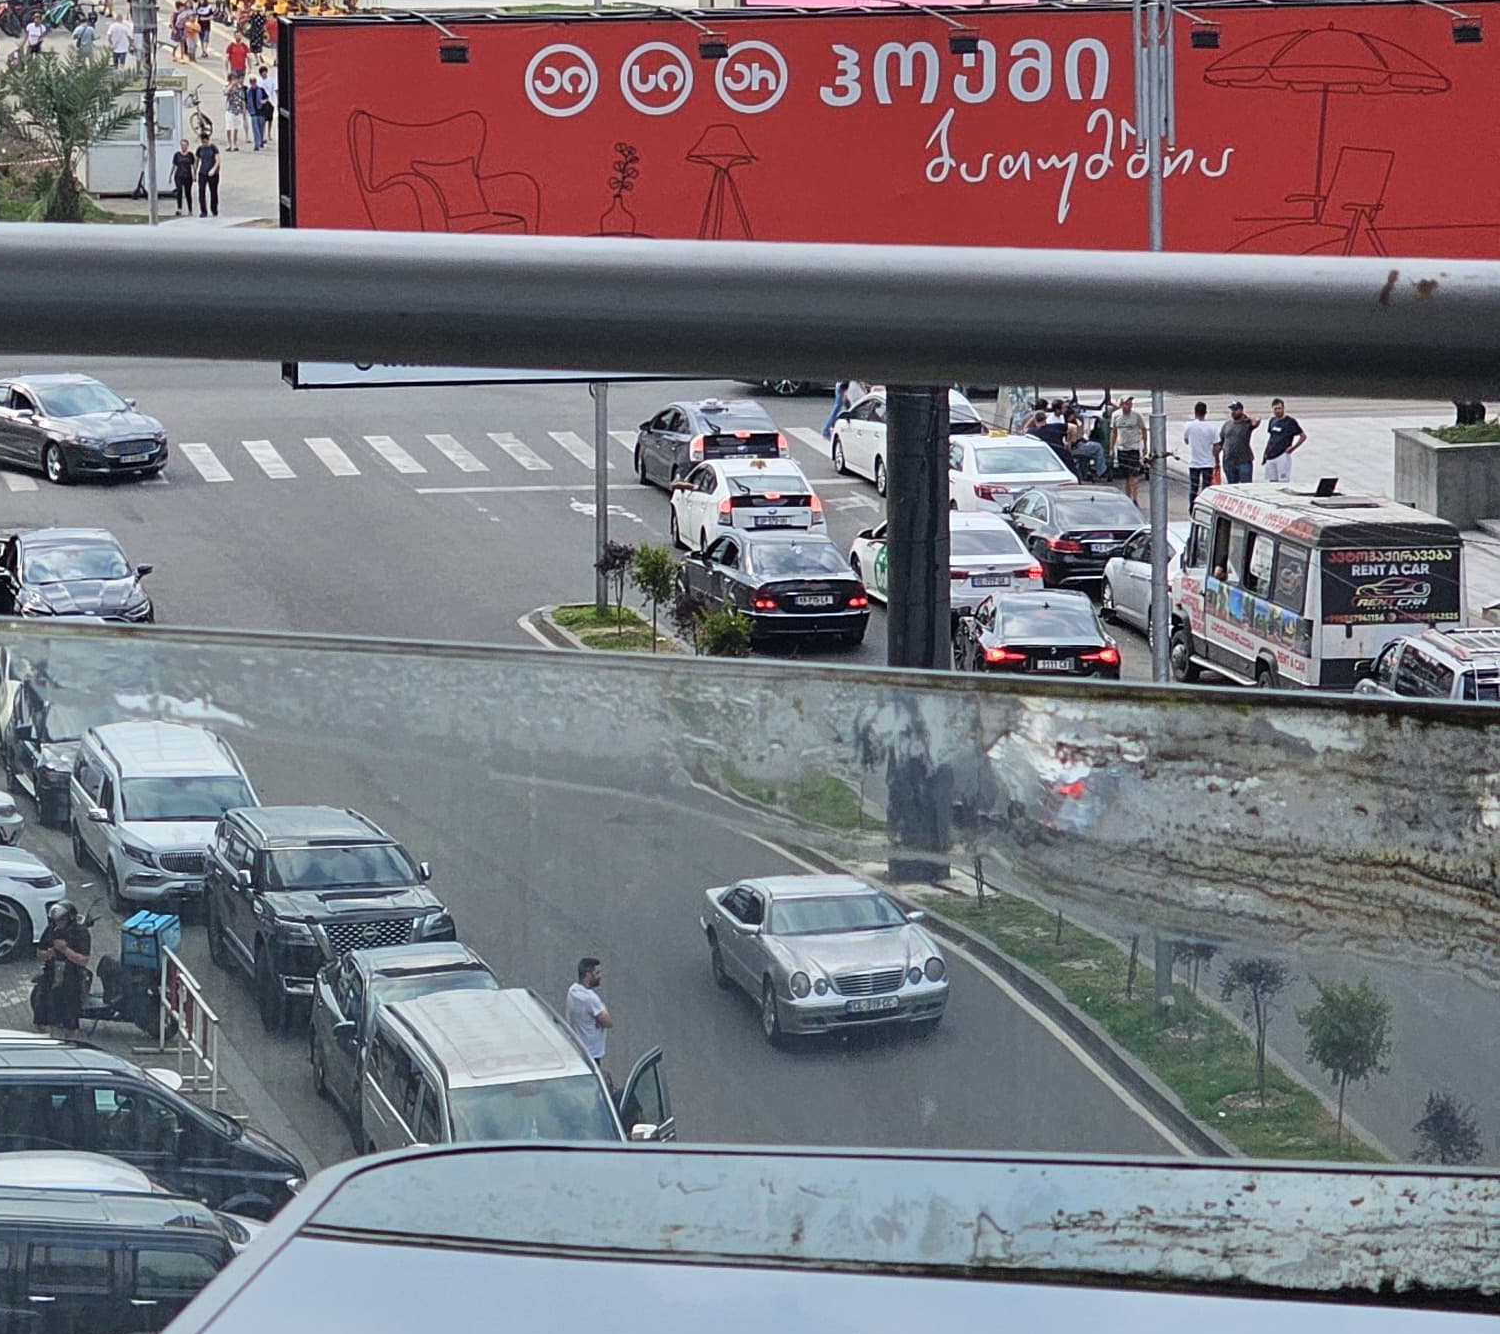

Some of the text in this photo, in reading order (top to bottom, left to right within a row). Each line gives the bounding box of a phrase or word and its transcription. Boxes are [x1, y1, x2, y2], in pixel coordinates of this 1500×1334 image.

[1351, 563, 1430, 577] RENT A CAR
